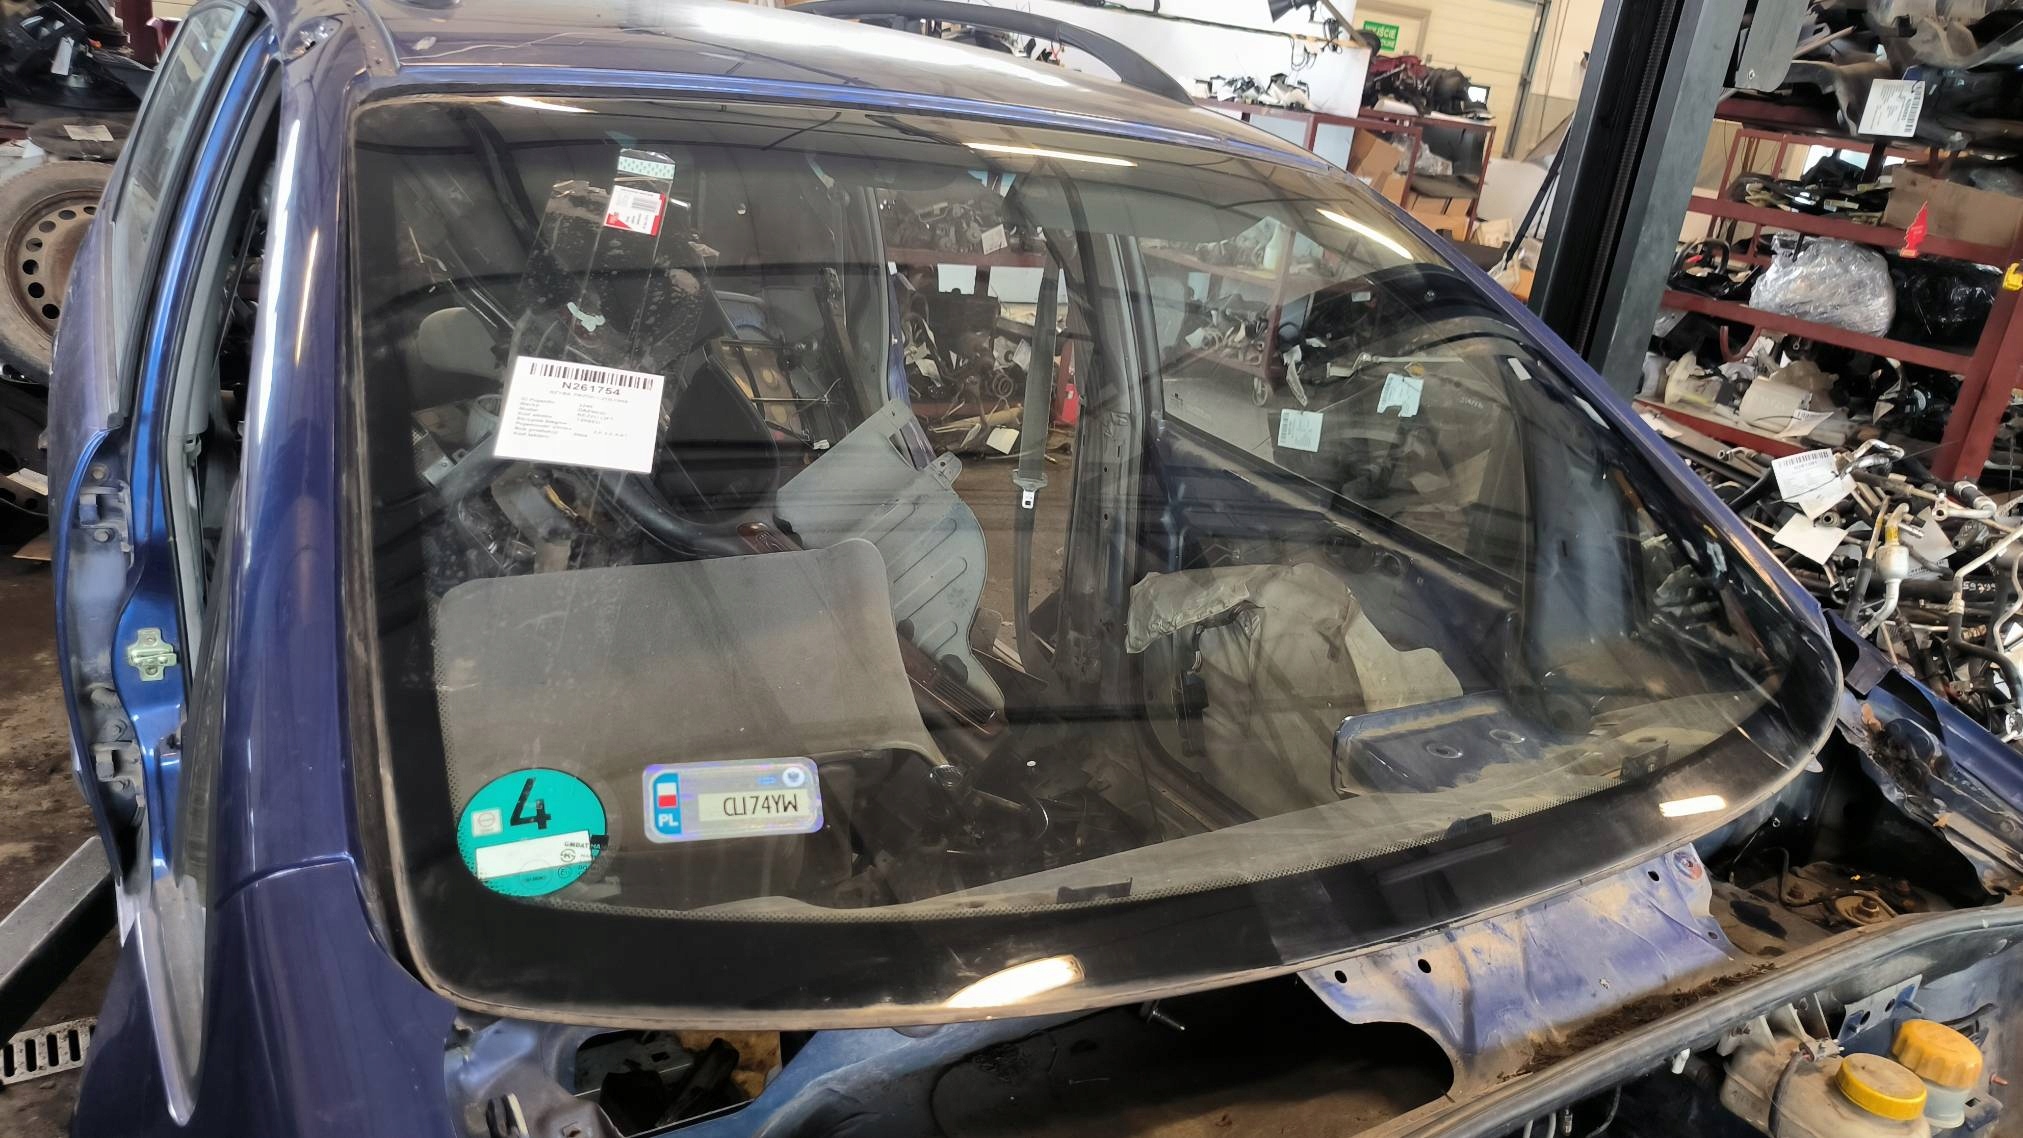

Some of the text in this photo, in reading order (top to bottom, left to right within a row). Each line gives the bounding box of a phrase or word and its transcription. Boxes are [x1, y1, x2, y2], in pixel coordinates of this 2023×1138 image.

[561, 381, 621, 396] N261754
[510, 777, 552, 830] 4
[657, 813, 680, 828] PL
